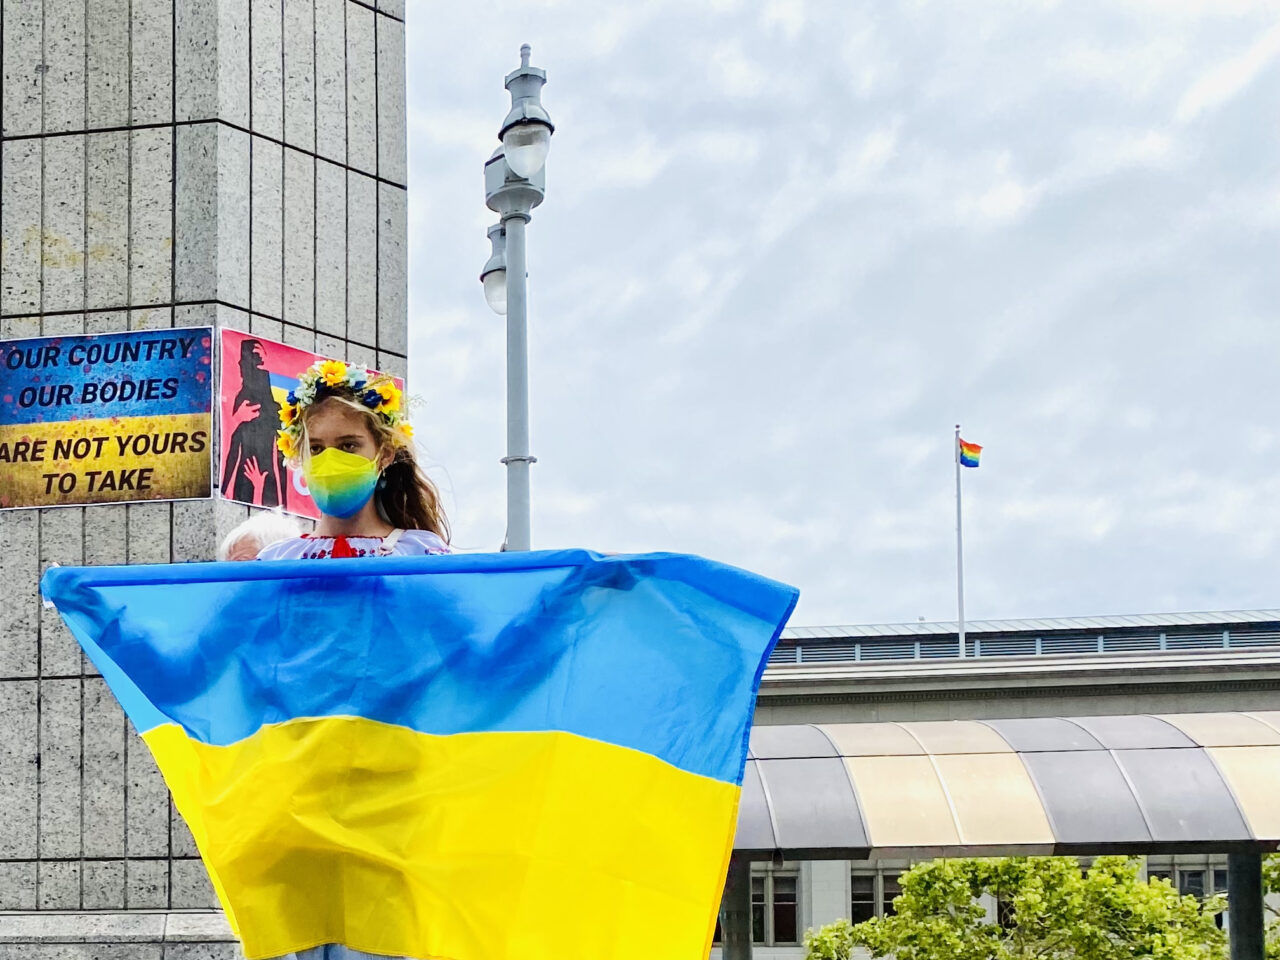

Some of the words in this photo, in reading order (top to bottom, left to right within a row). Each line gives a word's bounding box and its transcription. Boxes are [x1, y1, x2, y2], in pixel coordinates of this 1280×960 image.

[6, 345, 60, 370] OUR
[69, 337, 196, 366] COUNTRY
[18, 384, 74, 408] OUR
[80, 377, 179, 404] BODIES
[52, 436, 109, 460] NOT
[116, 431, 207, 456] YOURS
[42, 472, 76, 494] TO
[84, 467, 153, 492] TAKE
